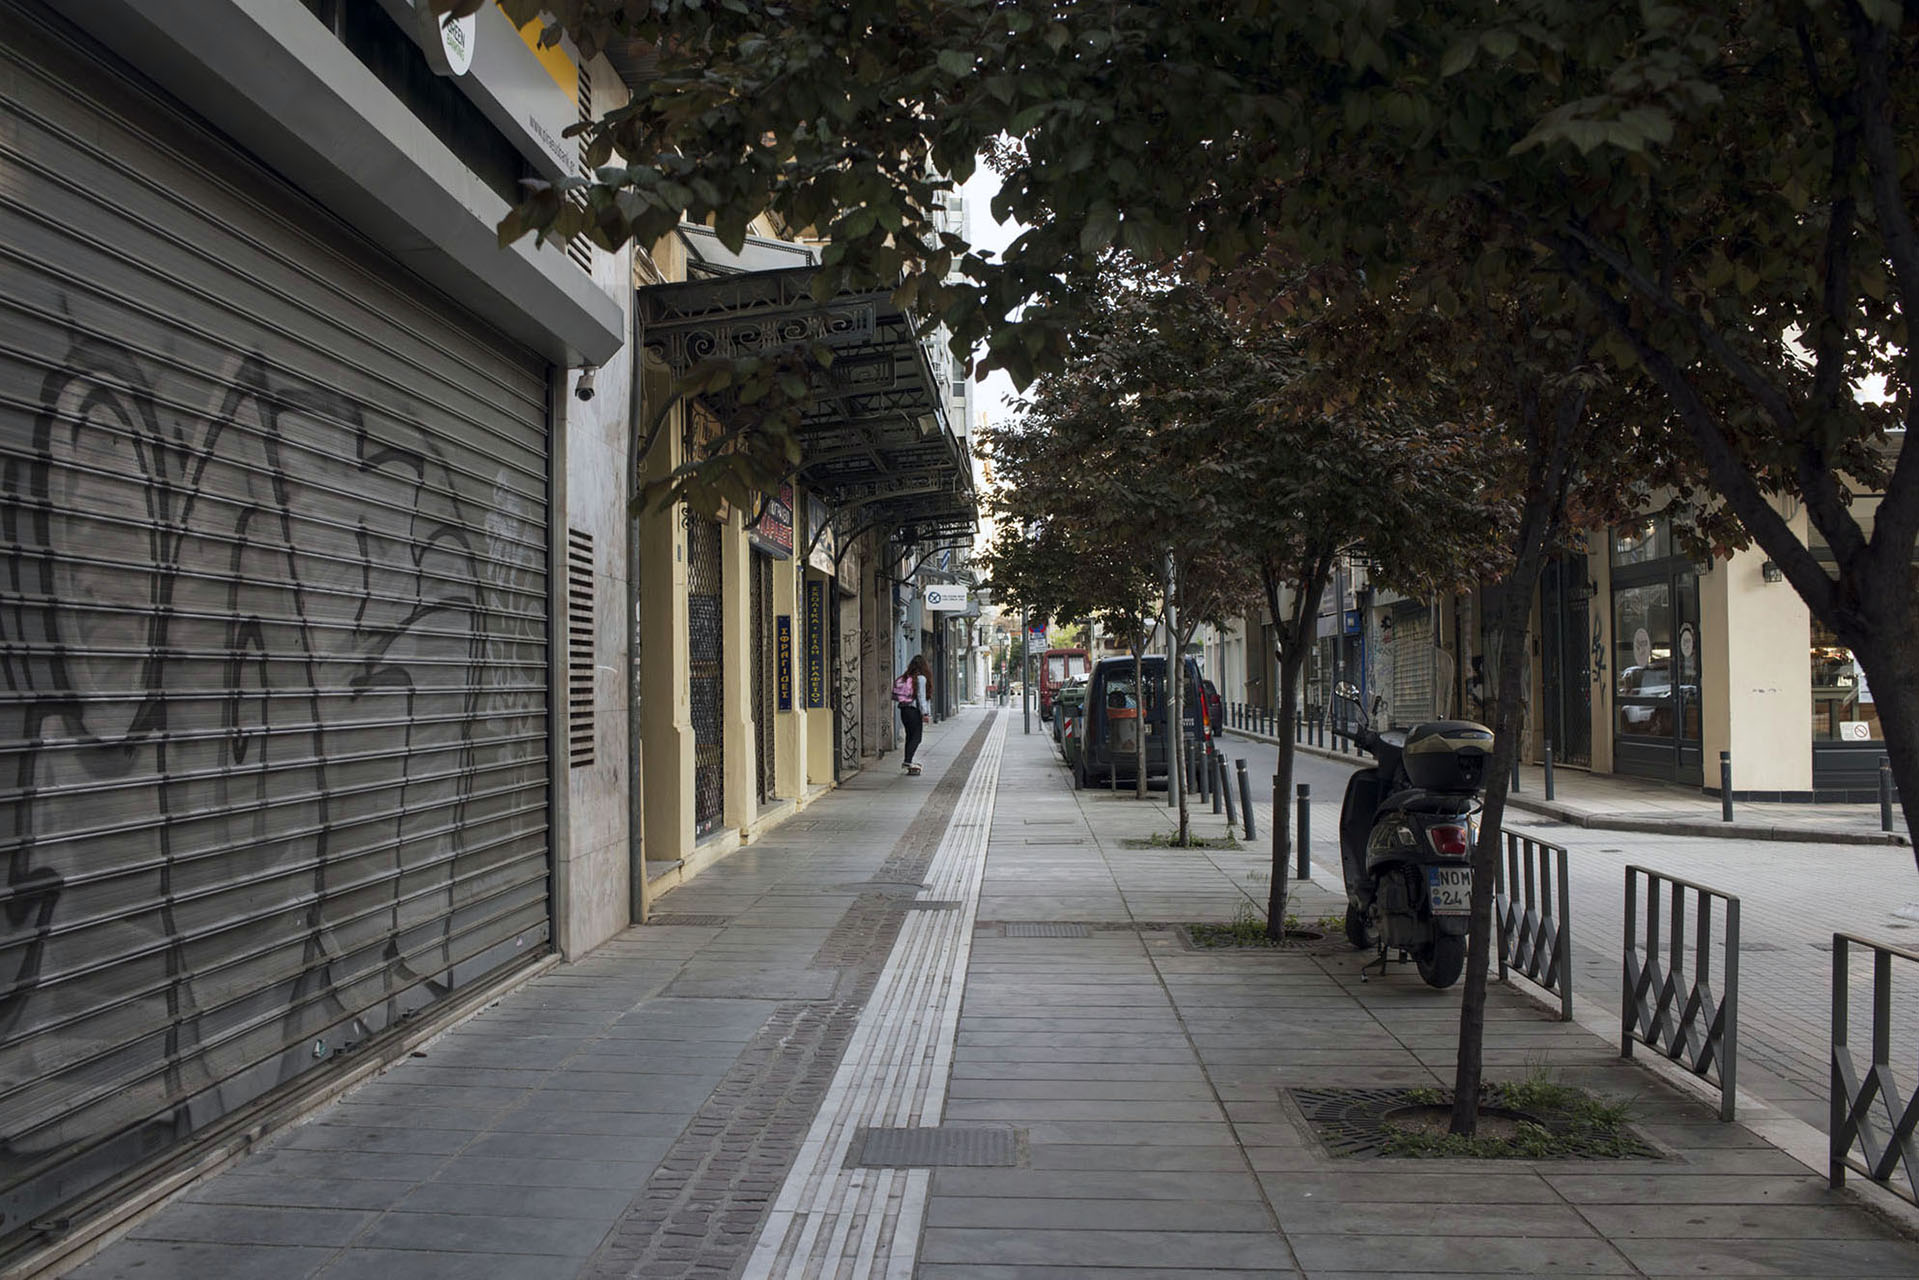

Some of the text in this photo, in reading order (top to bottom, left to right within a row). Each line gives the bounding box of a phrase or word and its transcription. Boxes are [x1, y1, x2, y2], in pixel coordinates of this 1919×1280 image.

[780, 627, 789, 698] ΣΦΡΑΓΙΔΕΣ
[811, 660, 820, 704] ΓΡΑΦΕΙΟΥ
[1440, 871, 1471, 885] NOM
